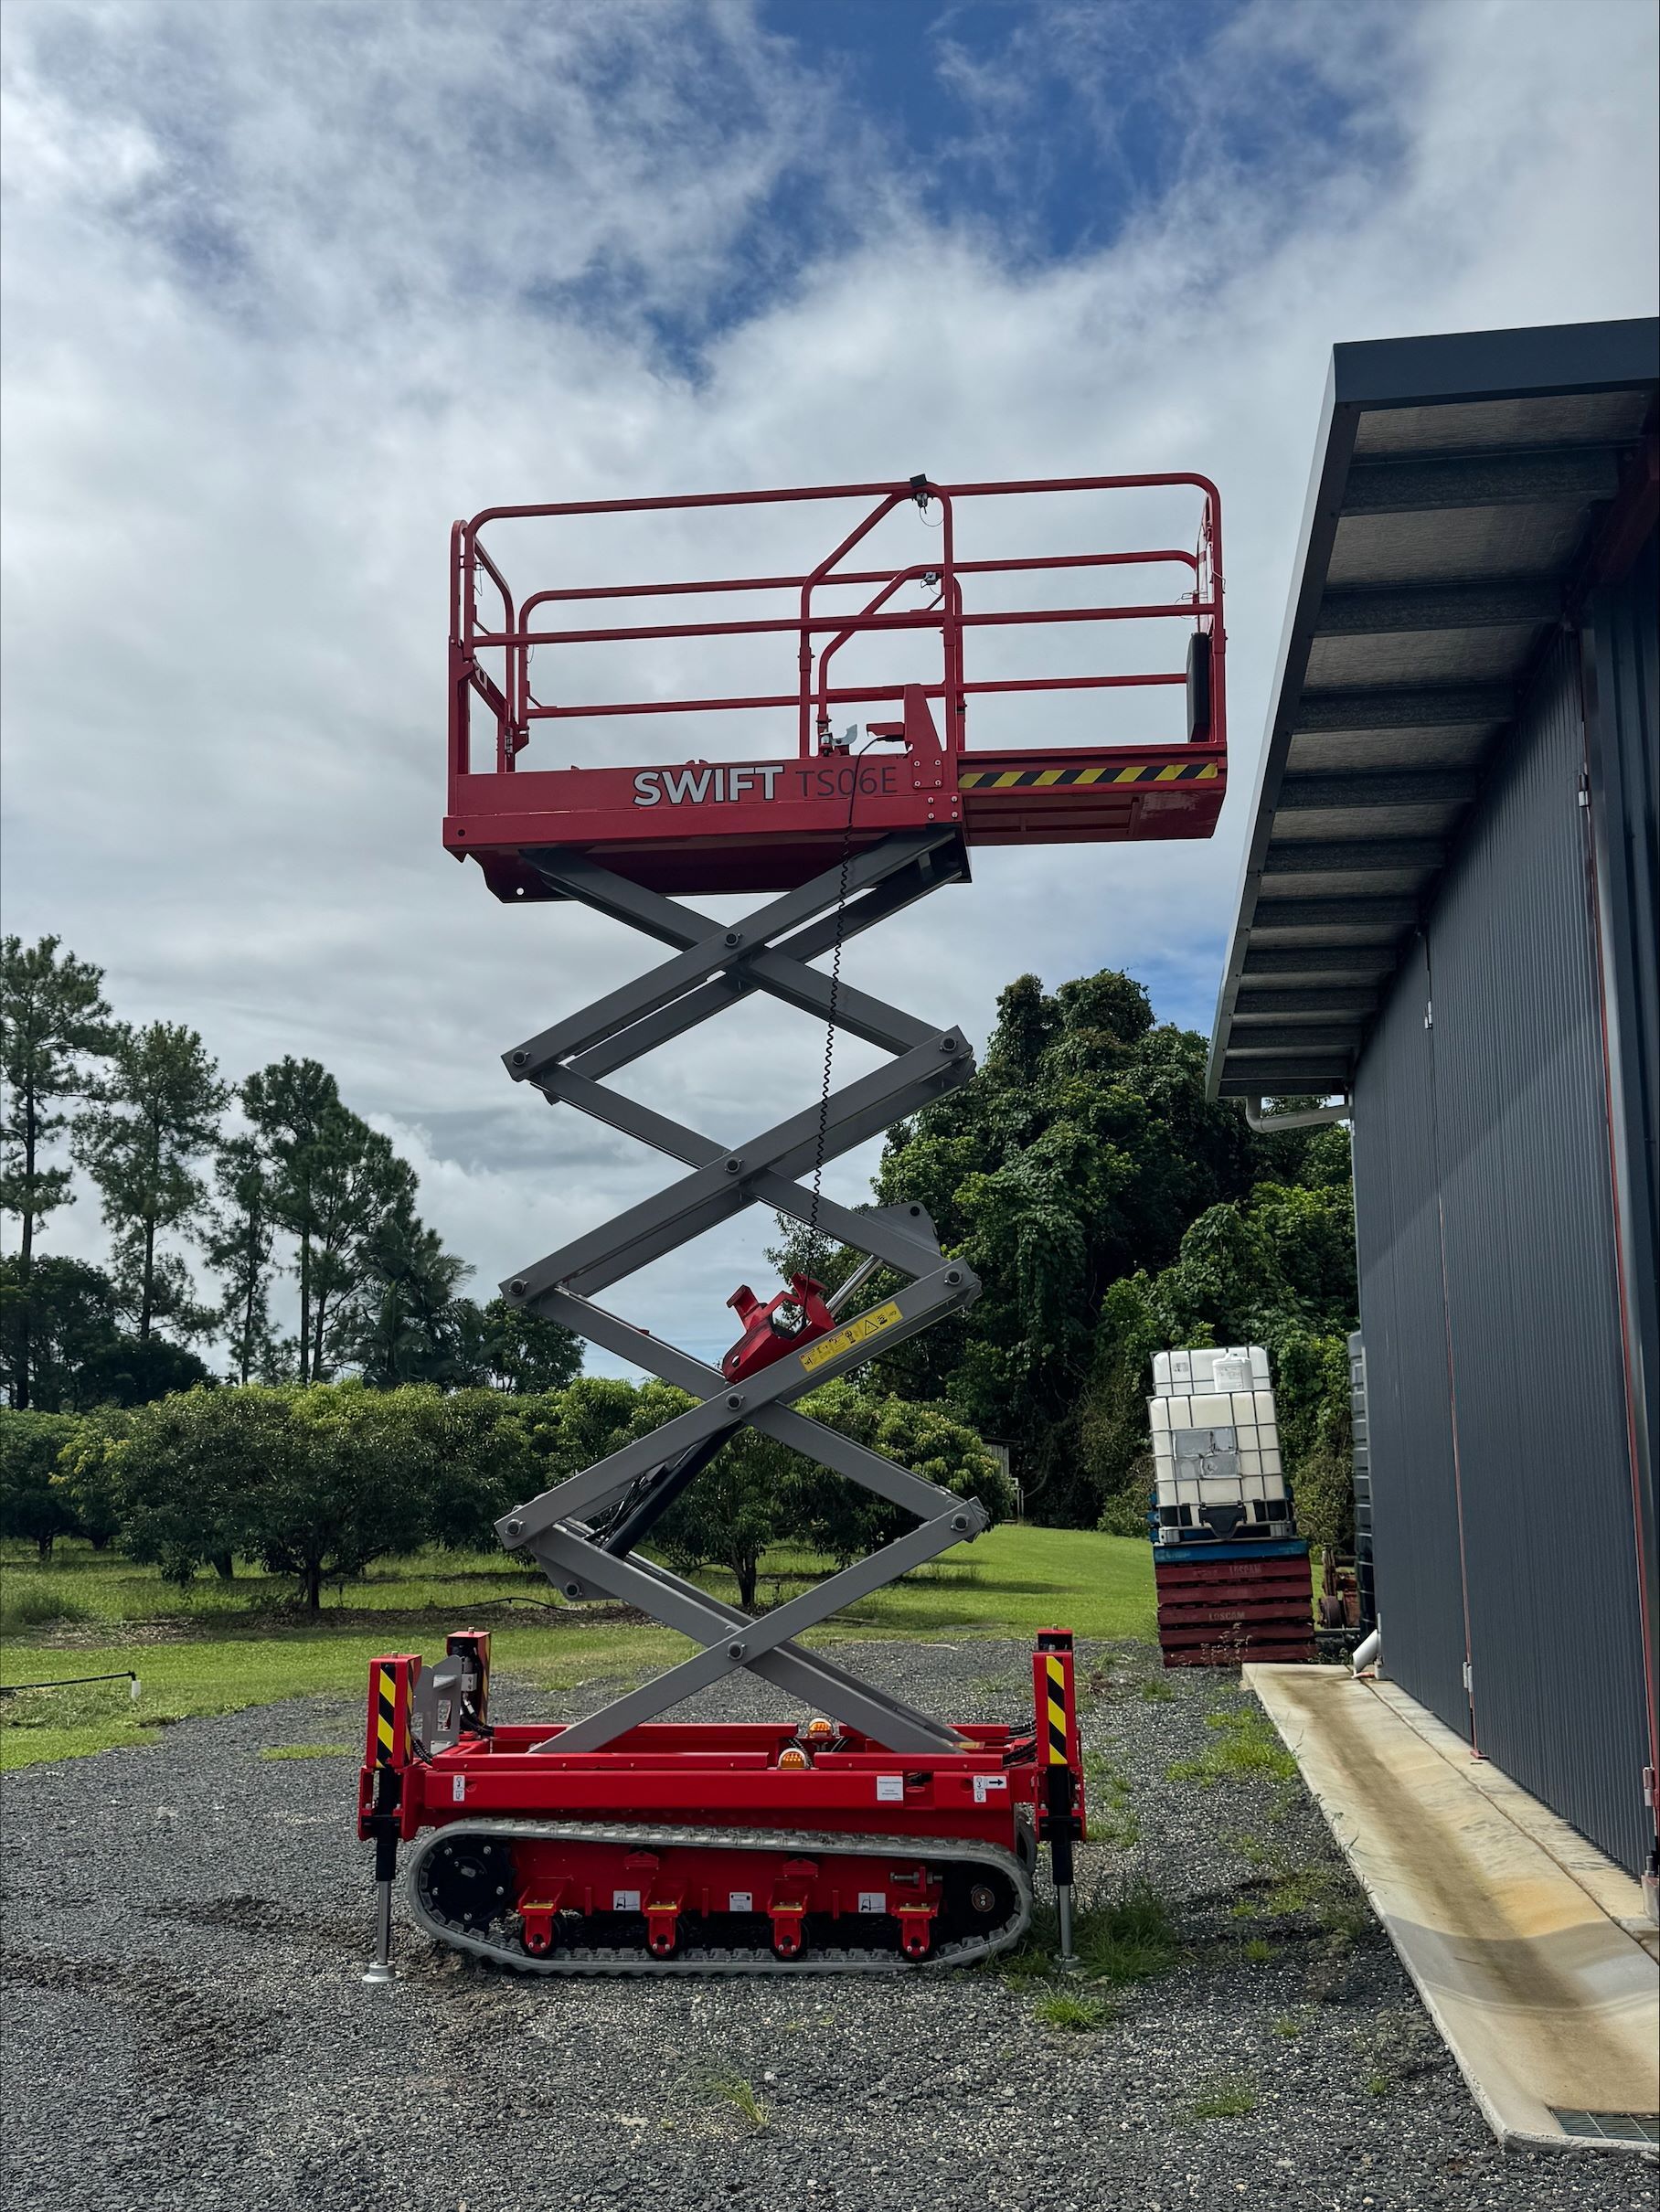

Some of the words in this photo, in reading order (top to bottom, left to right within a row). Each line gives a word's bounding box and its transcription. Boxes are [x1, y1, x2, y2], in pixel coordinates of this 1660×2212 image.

[633, 765, 784, 806] SWIFT
[795, 766, 898, 797] TS06E
[1208, 1611, 1246, 1622] LOSCAM
